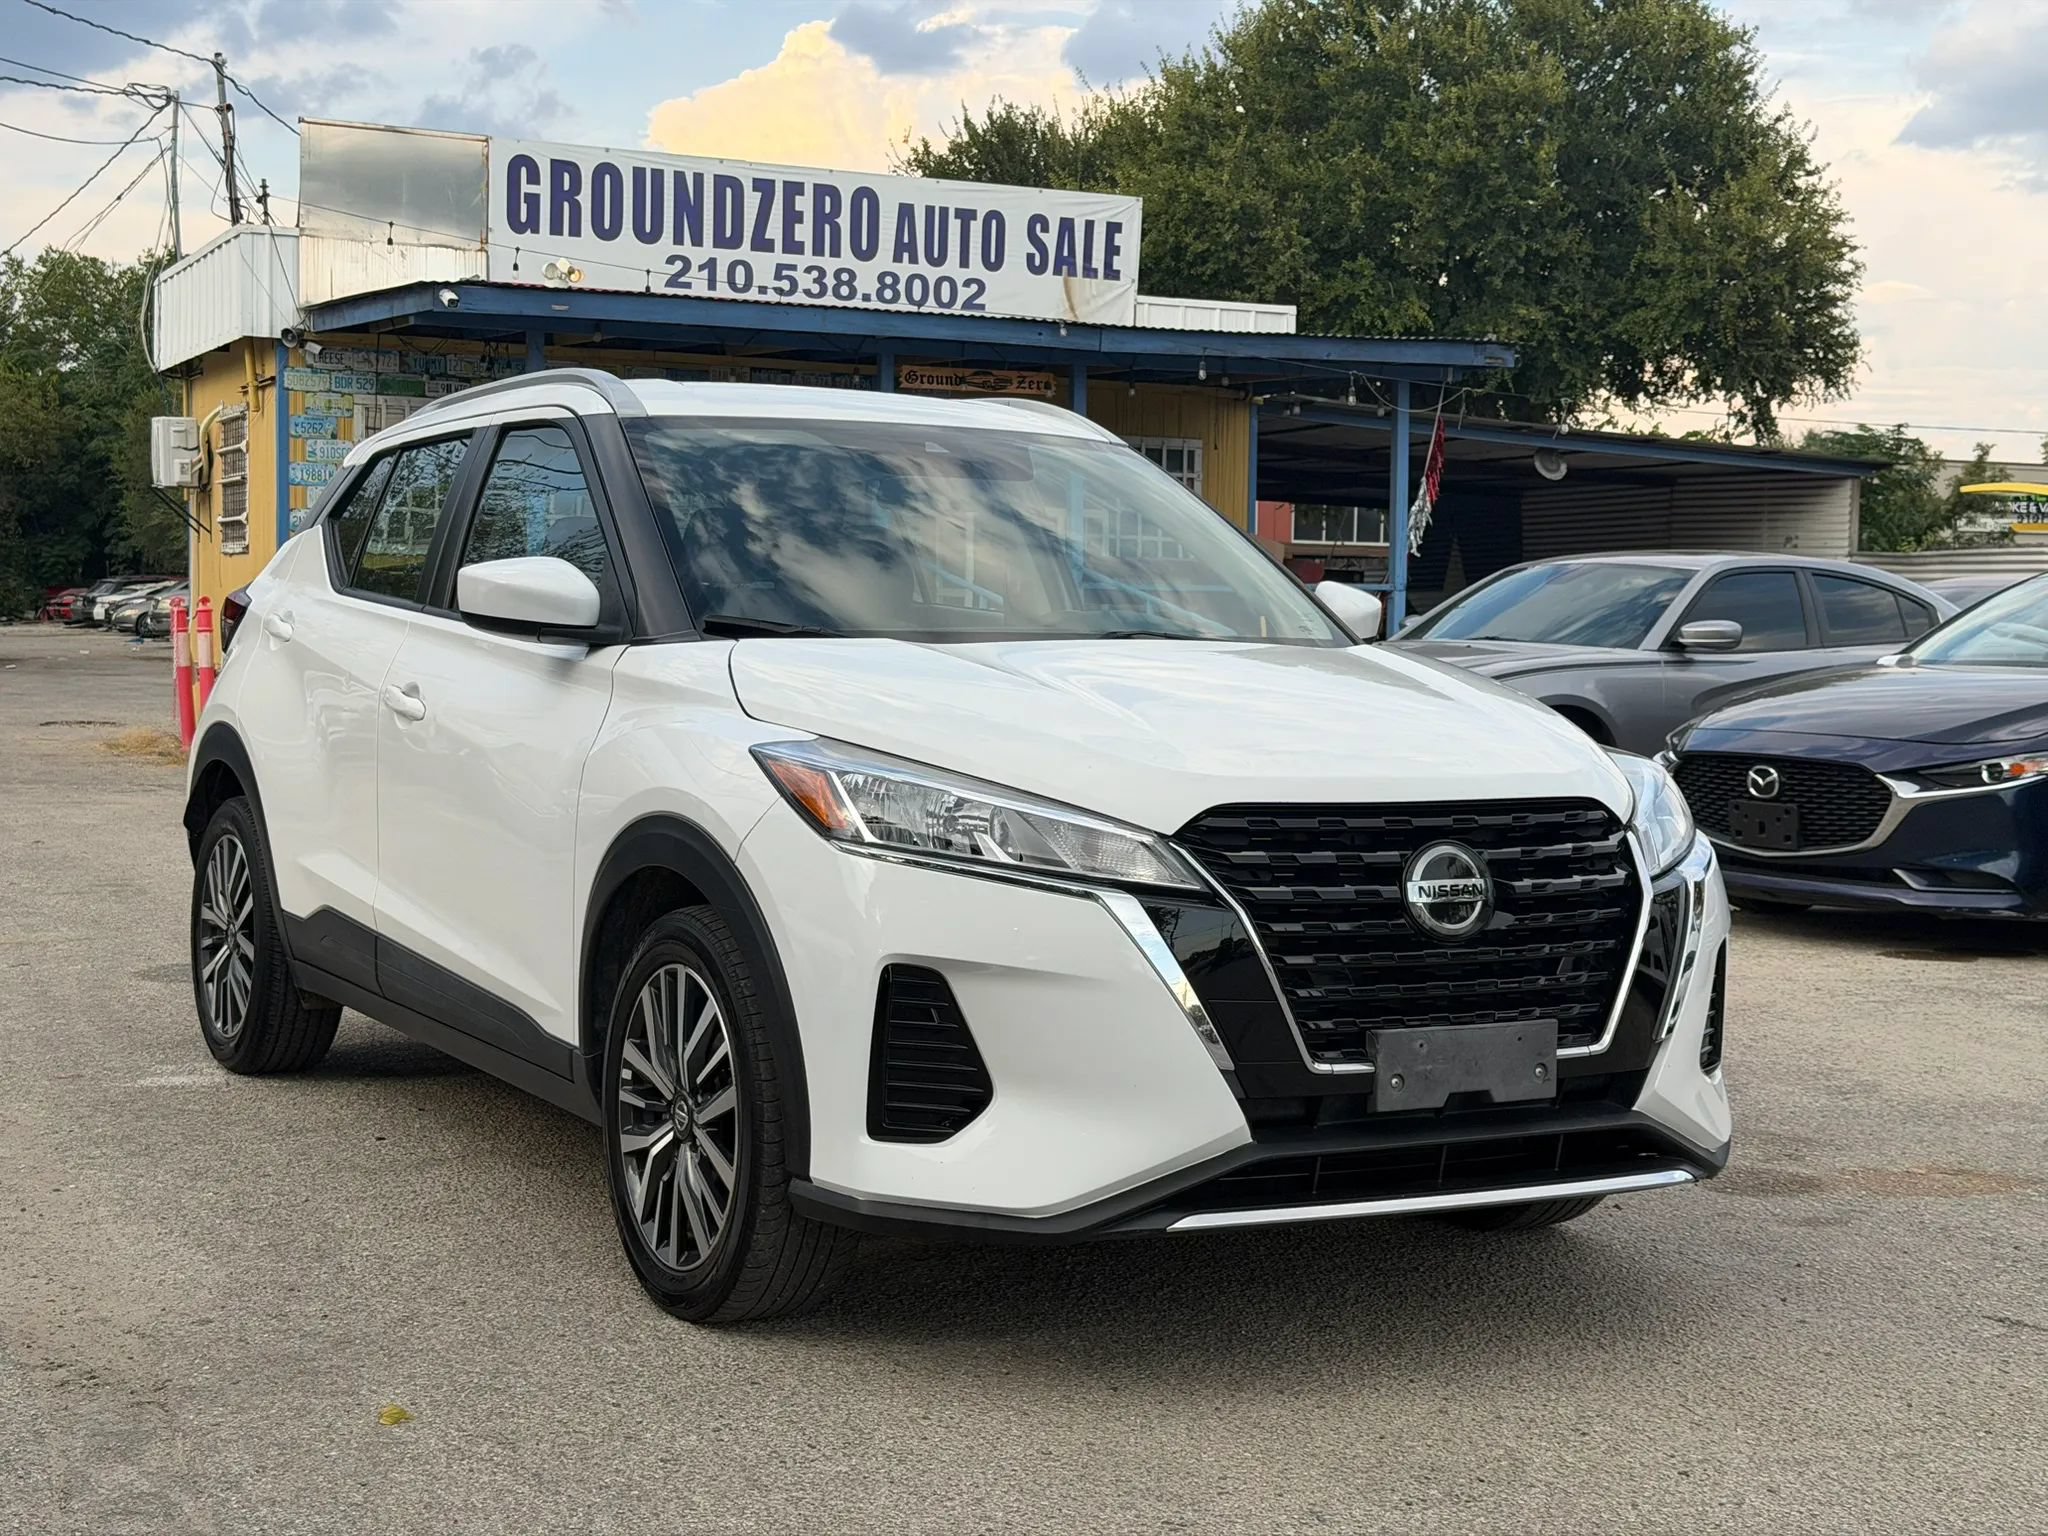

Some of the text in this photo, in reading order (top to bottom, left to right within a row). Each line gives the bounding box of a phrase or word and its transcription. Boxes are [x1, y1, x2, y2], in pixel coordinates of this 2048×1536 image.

[506, 153, 1123, 281] GROUNDZERO AUTO SALE
[664, 254, 987, 312] 210.538.8002
[334, 375, 375, 391] BDR 529
[904, 369, 962, 386] Ground
[1418, 883, 1483, 898] NISSAN
